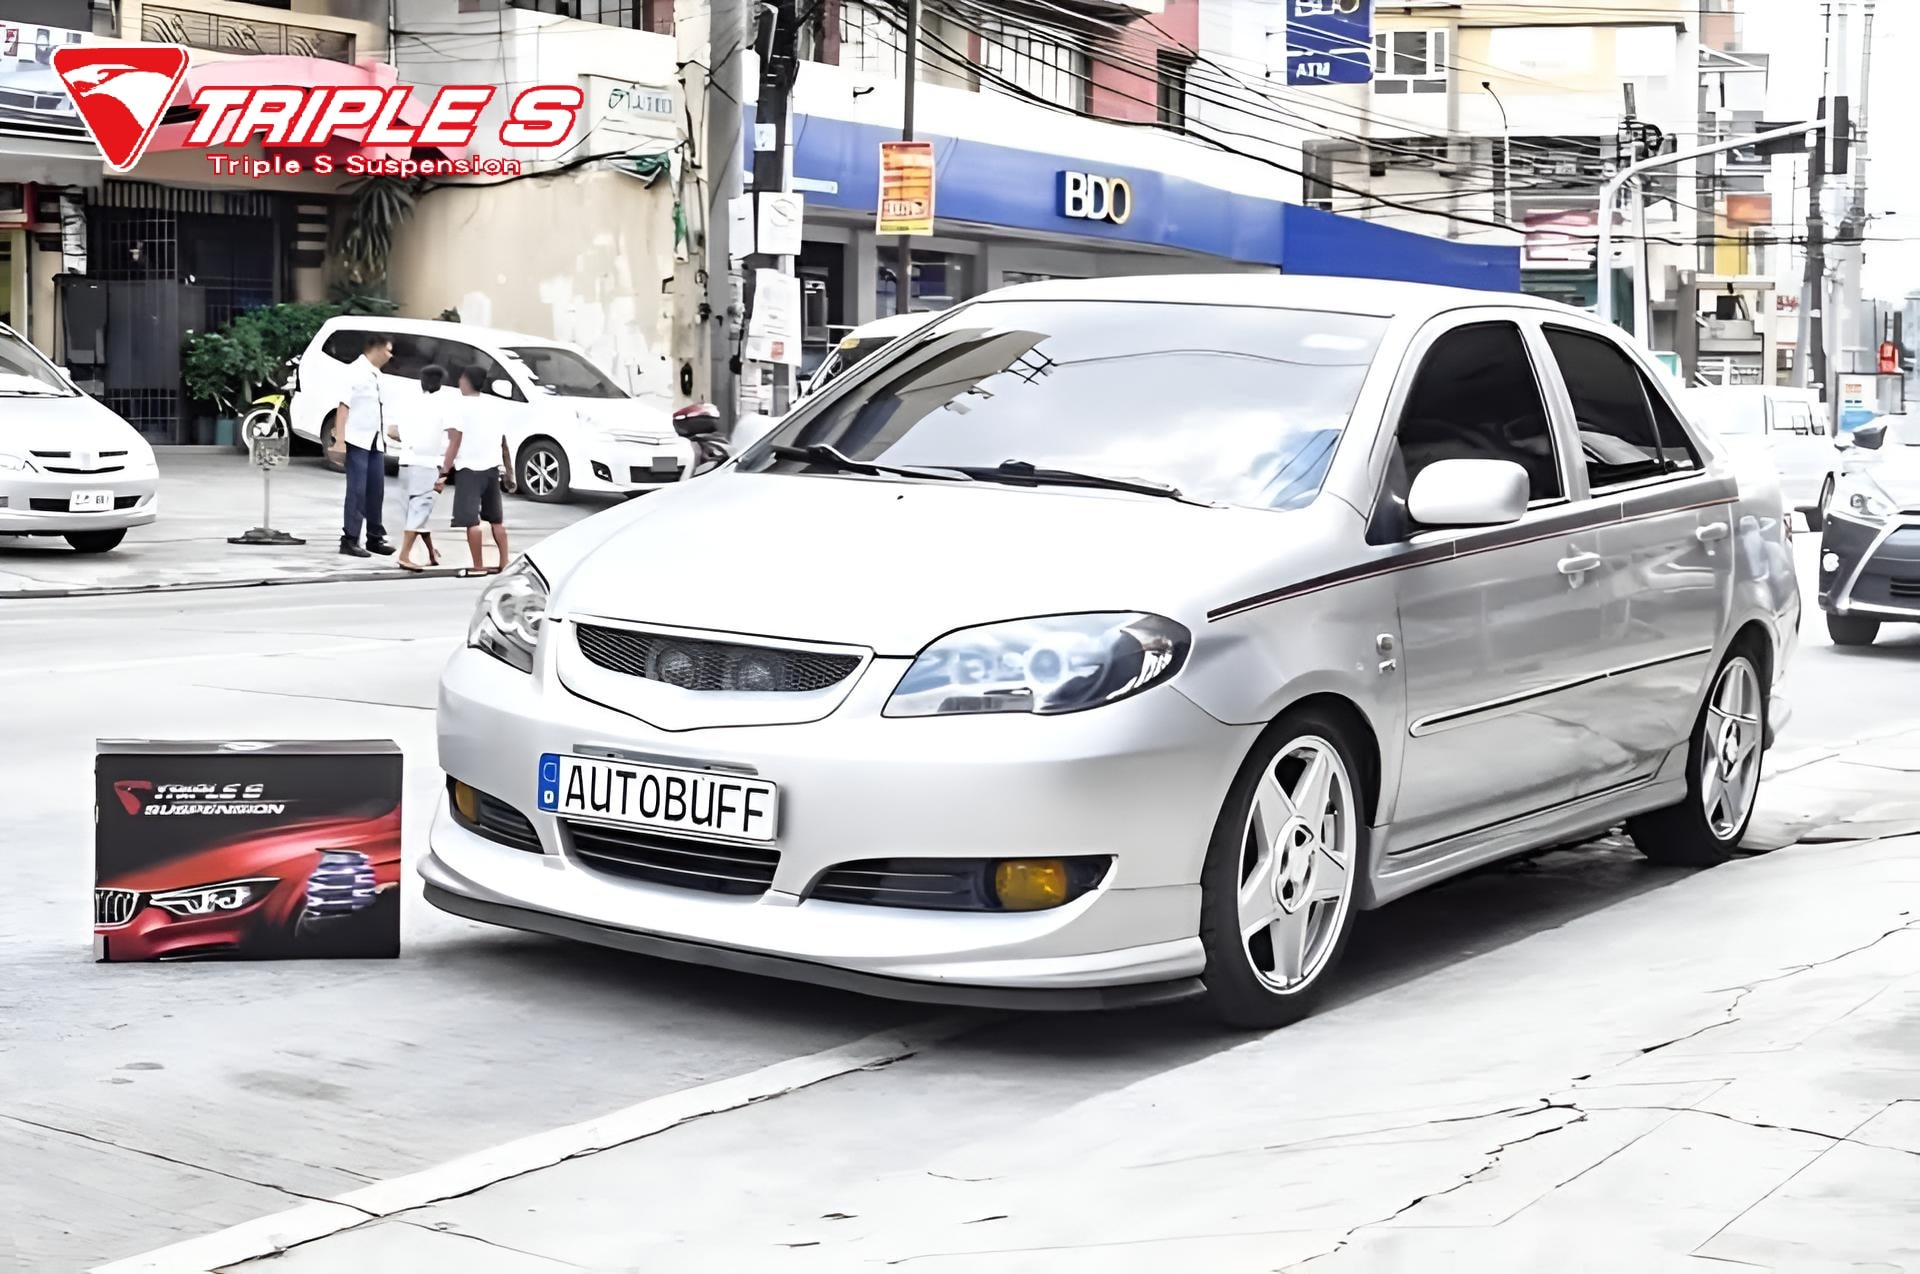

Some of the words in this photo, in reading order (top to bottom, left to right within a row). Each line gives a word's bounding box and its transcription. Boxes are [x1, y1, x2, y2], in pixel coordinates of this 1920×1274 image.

[1296, 62, 1330, 78] ATM
[1065, 170, 1131, 225] BDO
[565, 765, 769, 832] AUTOBUFF
